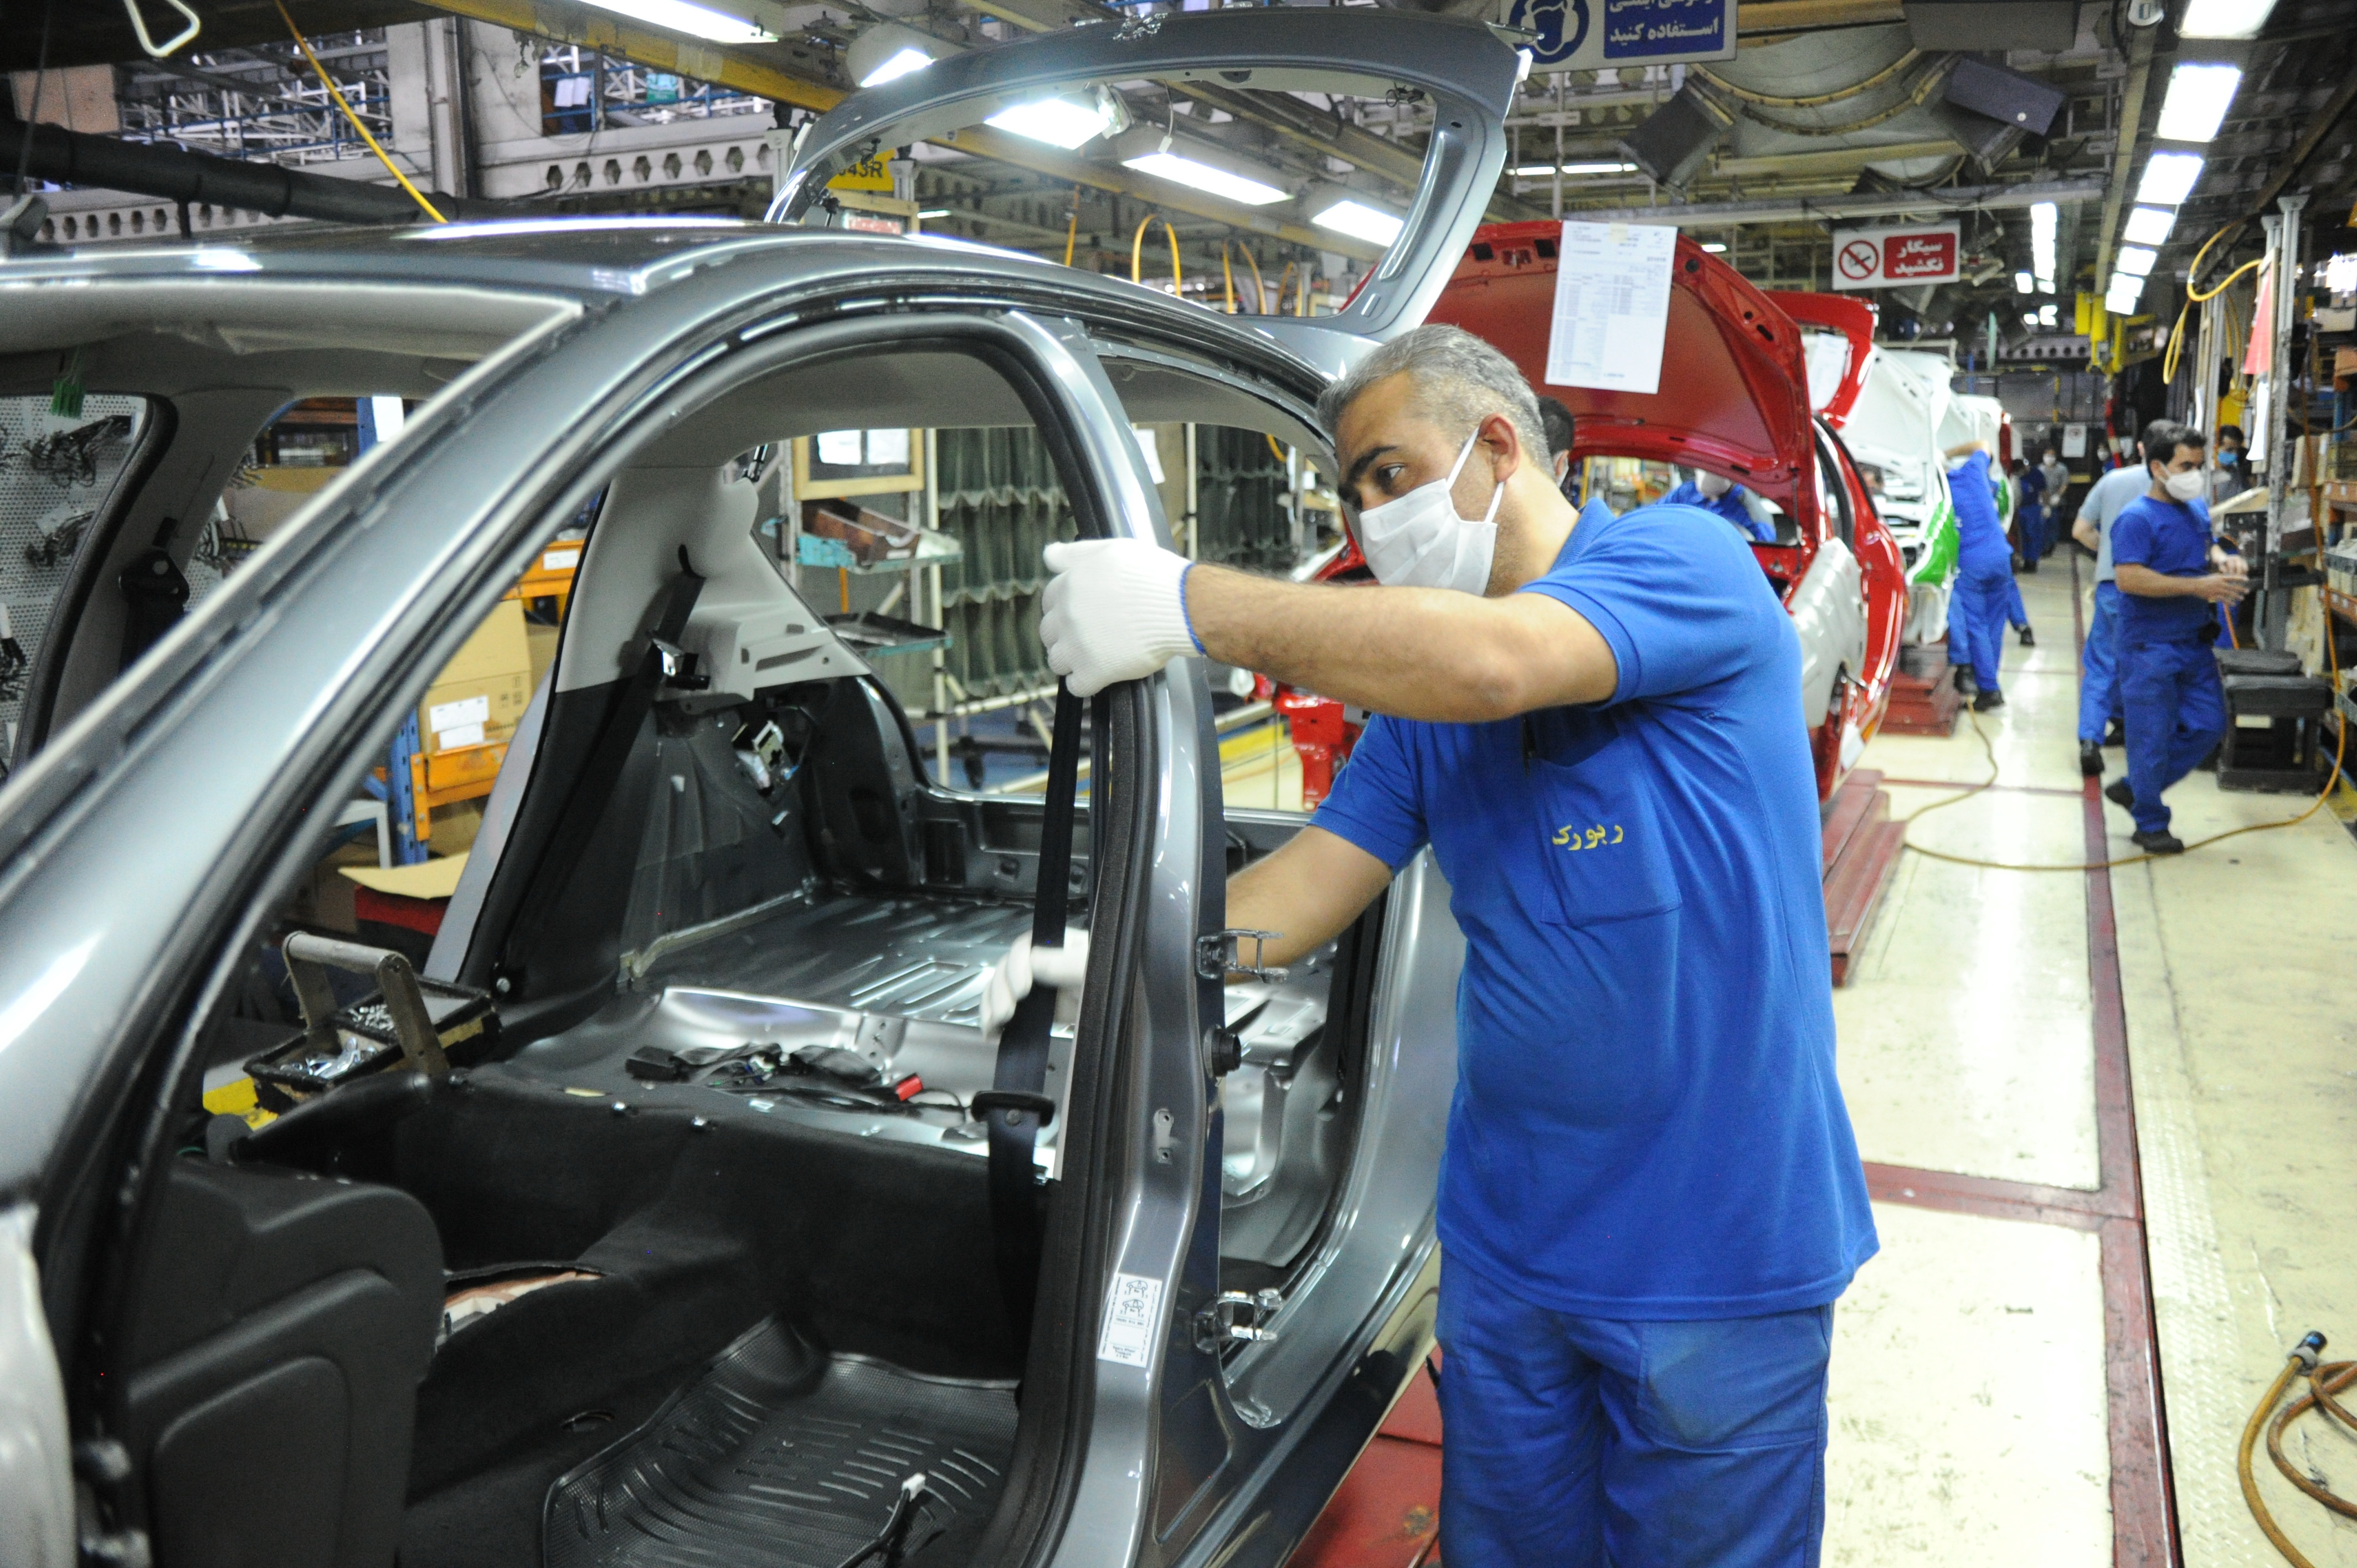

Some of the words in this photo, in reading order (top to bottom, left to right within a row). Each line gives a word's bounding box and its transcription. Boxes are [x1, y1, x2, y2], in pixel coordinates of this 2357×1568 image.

[1609, 23, 1645, 46] کنید
[1647, 16, 1719, 40] استفاده
[1894, 257, 1944, 276] نکشید
